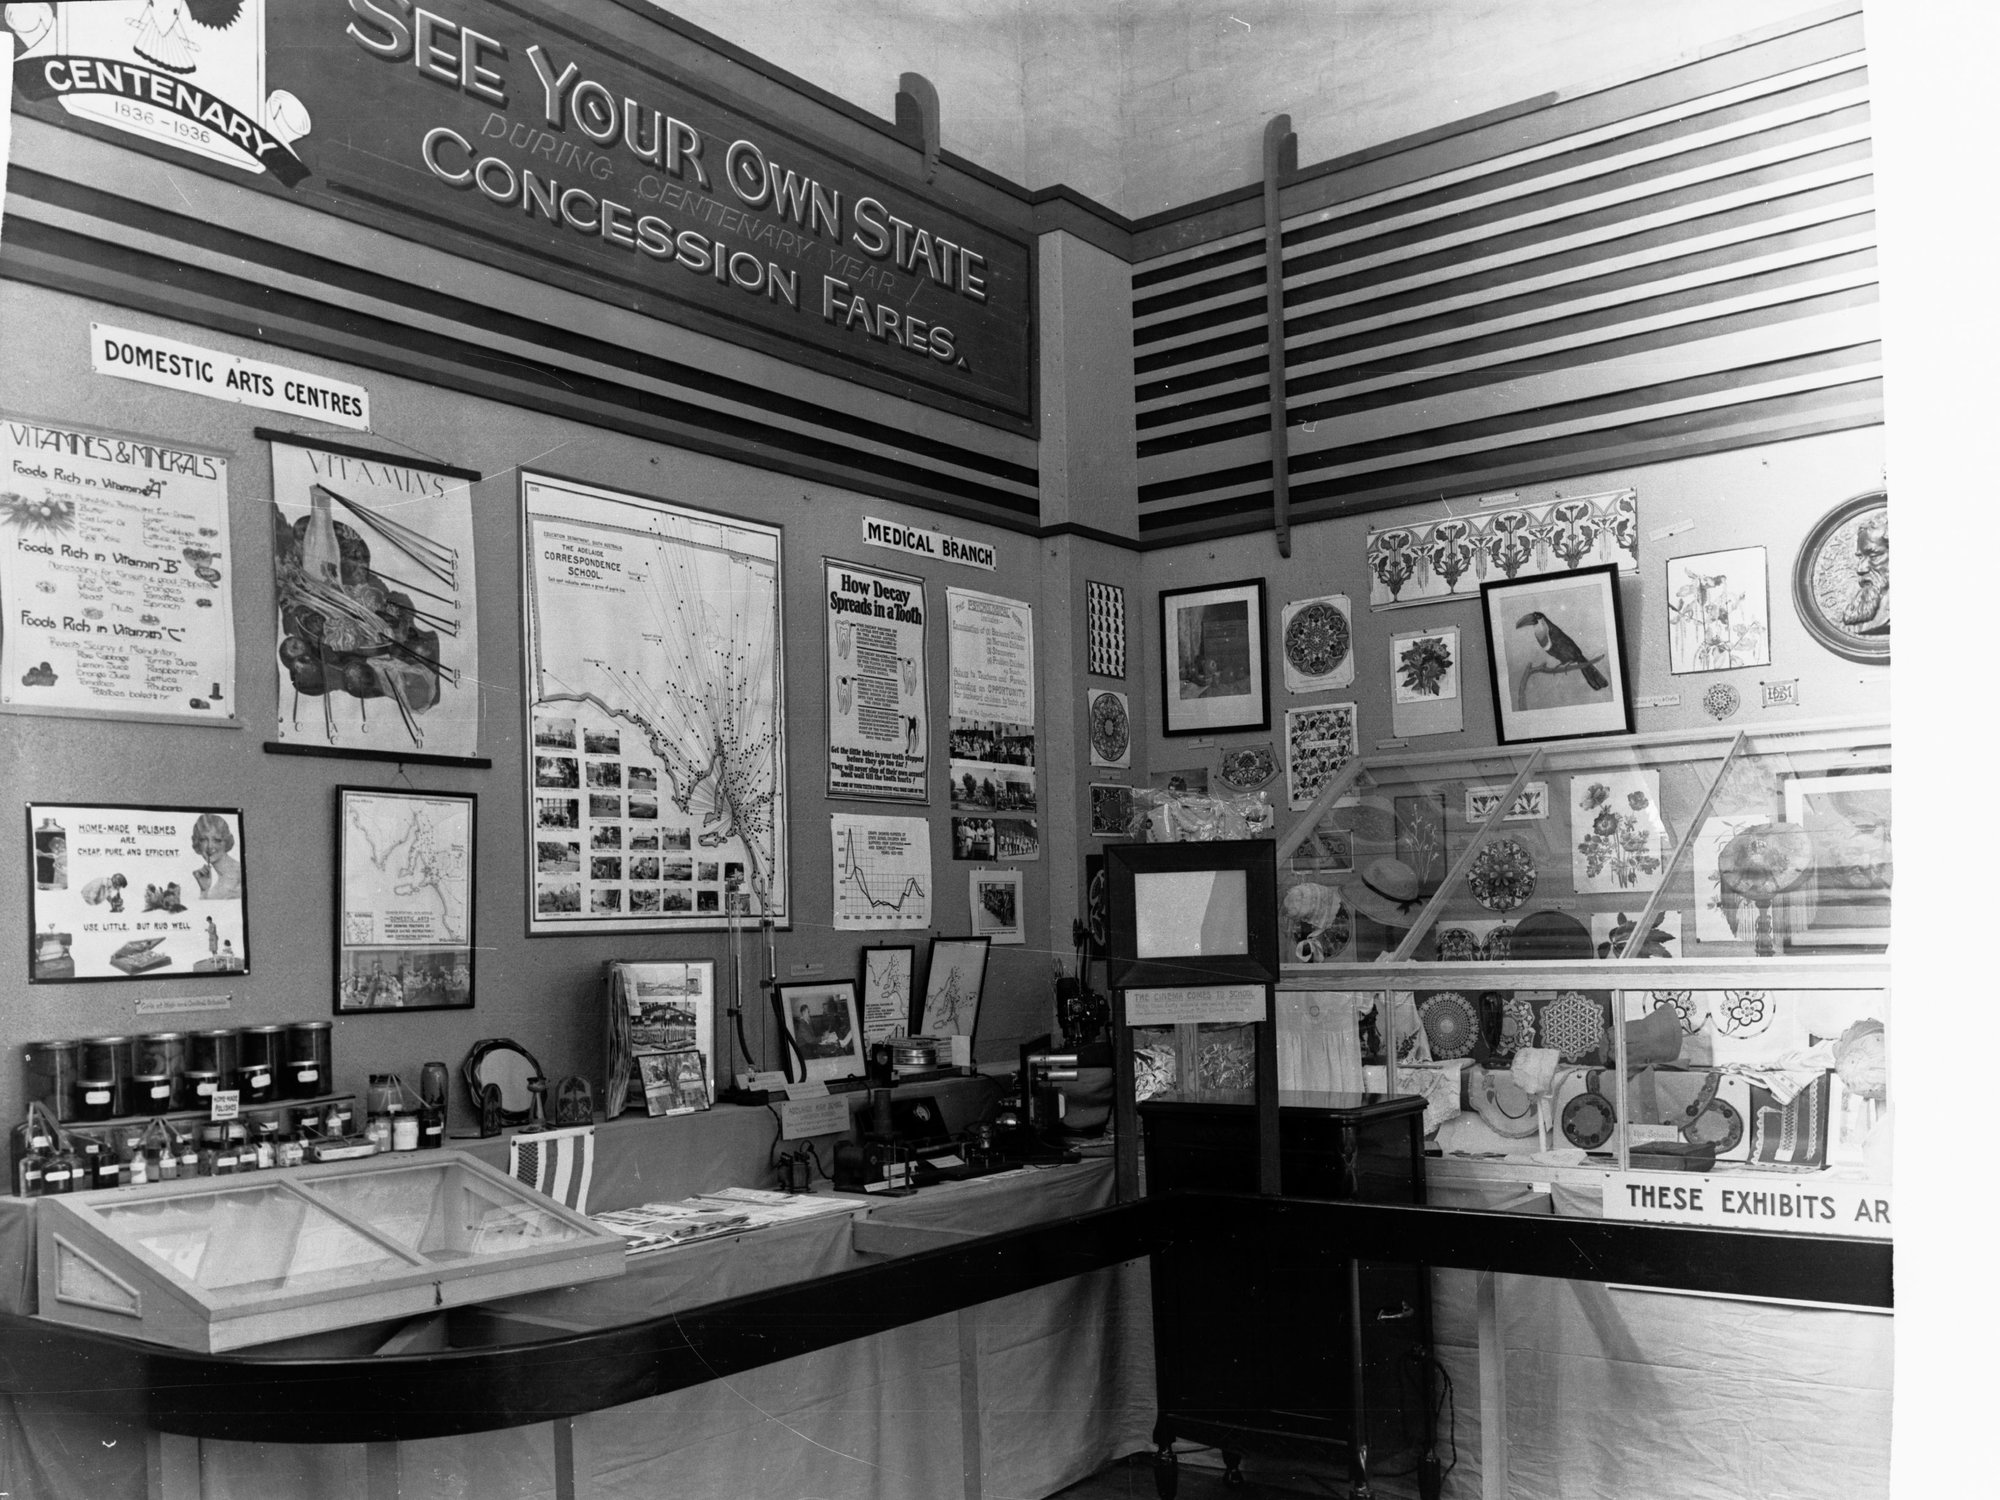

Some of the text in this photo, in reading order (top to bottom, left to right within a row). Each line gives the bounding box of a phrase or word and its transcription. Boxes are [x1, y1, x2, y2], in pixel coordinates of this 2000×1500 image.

[45, 60, 278, 157] CENTENARY
[346, 0, 988, 300] SEE YOUR OWN STATE
[481, 112, 613, 180] DURING
[638, 175, 814, 258] CENTENARY
[423, 127, 798, 308] CONCESSION
[105, 339, 363, 417] DOMESTIC ARTS CENTRES
[115, 441, 130, 463] &
[13, 460, 48, 479] Foods
[54, 467, 81, 485] Rich
[85, 477, 97, 487] in
[562, 544, 604, 558] THE ADELAIDE
[604, 542, 623, 551] AUSTRALIA
[868, 522, 993, 566] MEDICAL BRANCH
[18, 538, 54, 555] Foods
[61, 544, 88, 560] Rich
[95, 552, 105, 563] in
[112, 552, 160, 570] Vitamin
[544, 551, 622, 572] CORRESPONDENCE
[107, 586, 135, 596] Germ
[144, 591, 185, 603] Tomatoes
[143, 584, 182, 594] Oranges
[841, 574, 911, 607] How Decay
[78, 592, 181, 610] Yeast Spinach
[111, 603, 134, 613] Nuts
[454, 600, 461, 609] B
[830, 591, 922, 625] Spreads in a Tooth
[21, 610, 57, 628] Foods
[63, 617, 91, 632] Rich
[97, 625, 108, 633] in
[113, 624, 162, 639] Vitamin
[454, 620, 460, 630] B
[84, 641, 116, 653] Scurvy
[129, 645, 177, 657] Malnutrition
[96, 652, 130, 664] Cabbage
[77, 660, 200, 675] Lemon Juice Raspberries
[76, 669, 178, 684] Orange Juice Lettuce
[78, 677, 183, 692] Tomatoes Rhubarb
[987, 684, 1026, 698] OPPORTUNITY
[831, 746, 840, 754] Get
[840, 747, 848, 755] the
[849, 748, 861, 756] little
[847, 755, 864, 763] before
[865, 757, 877, 766] they
[878, 759, 885, 767] go
[831, 762, 843, 771] They
[886, 768, 898, 776] their
[883, 774, 897, 782] tooth
[78, 824, 176, 835] HOME-MADE POLISHES
[120, 836, 136, 844] ARE
[127, 848, 141, 856] AND
[84, 922, 98, 931] USE
[137, 922, 150, 930] BUT
[154, 922, 168, 930] RUB
[1134, 990, 1255, 1002] THE CINEMA COMES TO SCHOOL
[1626, 1184, 1704, 1211] THESE
[1722, 1190, 1836, 1219] EXHIBITS
